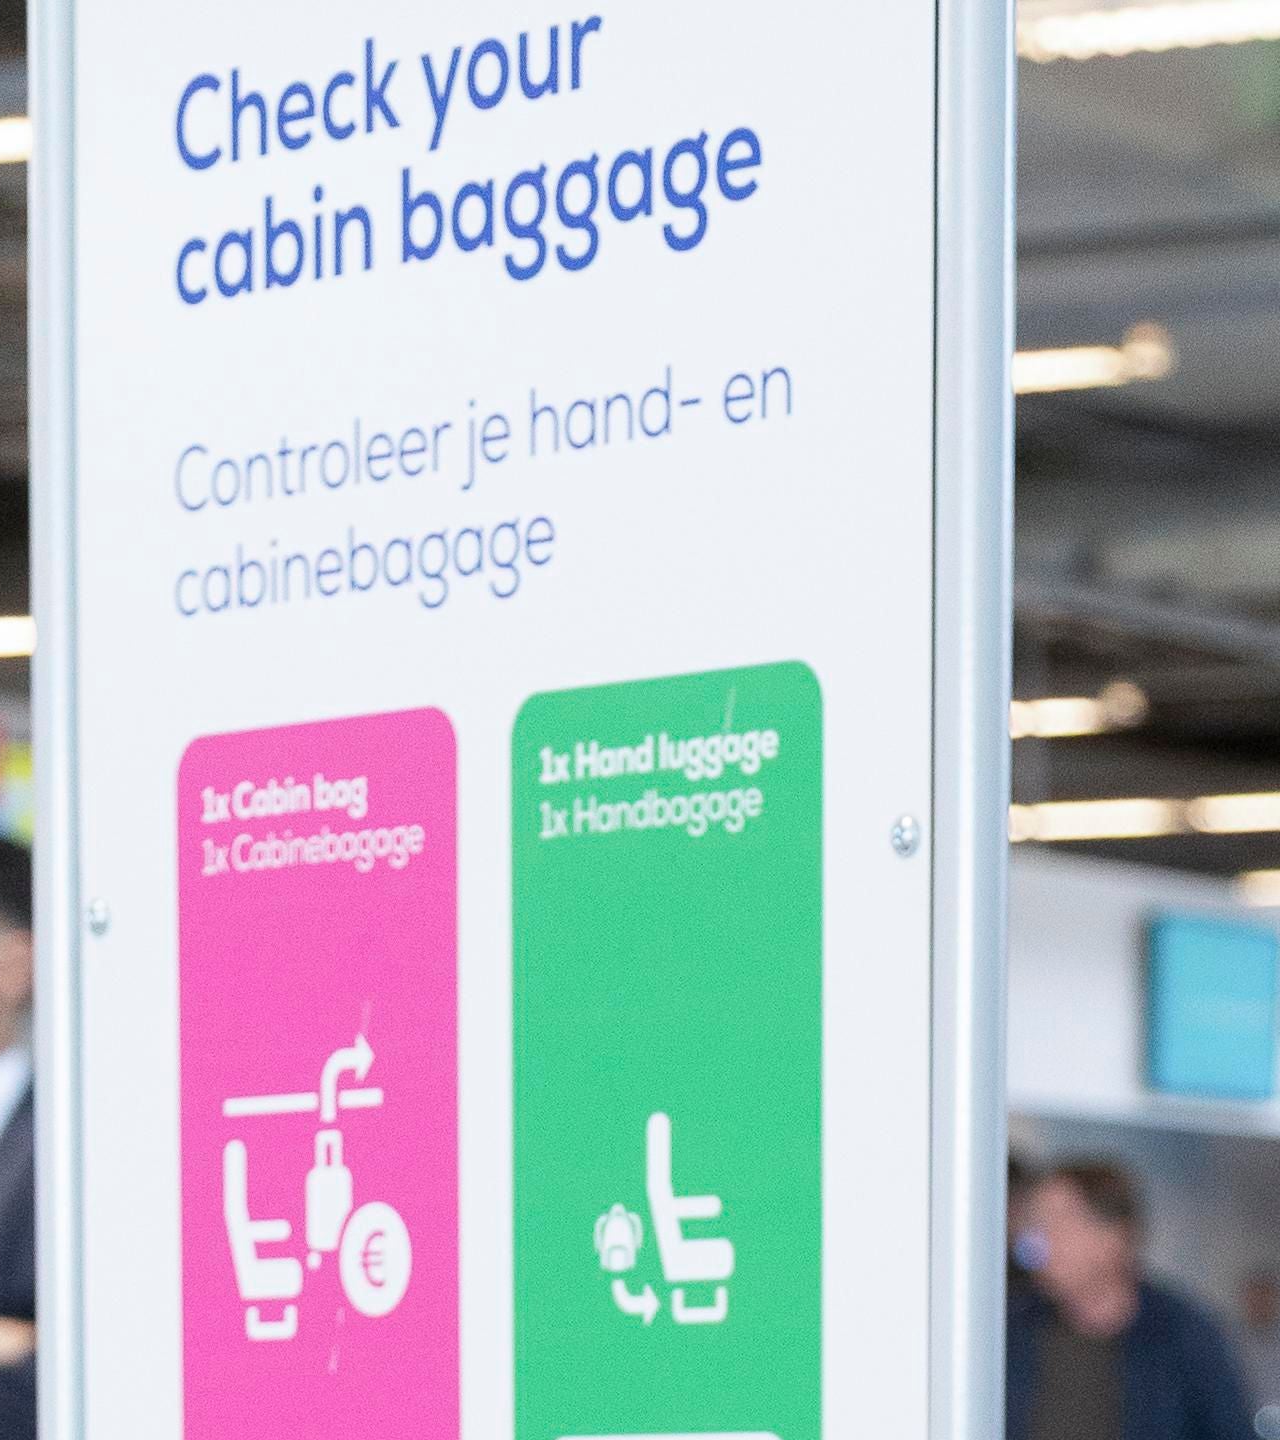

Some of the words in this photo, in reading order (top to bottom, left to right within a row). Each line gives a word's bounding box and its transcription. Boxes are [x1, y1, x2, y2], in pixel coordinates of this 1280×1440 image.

[176, 37, 401, 170] Check
[420, 15, 602, 151] your
[176, 186, 372, 305] cabin
[401, 126, 762, 280] baggage
[176, 419, 452, 513] Controleer
[461, 400, 511, 491] je
[529, 365, 702, 457] hand-
[723, 364, 794, 426] en
[176, 514, 556, 617] cabinebagage
[539, 746, 569, 784] 1x
[575, 733, 654, 780] Hand
[659, 729, 779, 781] luggage
[201, 785, 230, 824] 1x
[232, 776, 311, 820] Cabin
[313, 772, 368, 819] bag
[539, 801, 569, 840] 1x
[573, 787, 762, 837] Handbagage
[201, 839, 230, 876] 1x
[231, 824, 425, 873] Cabinebagage
